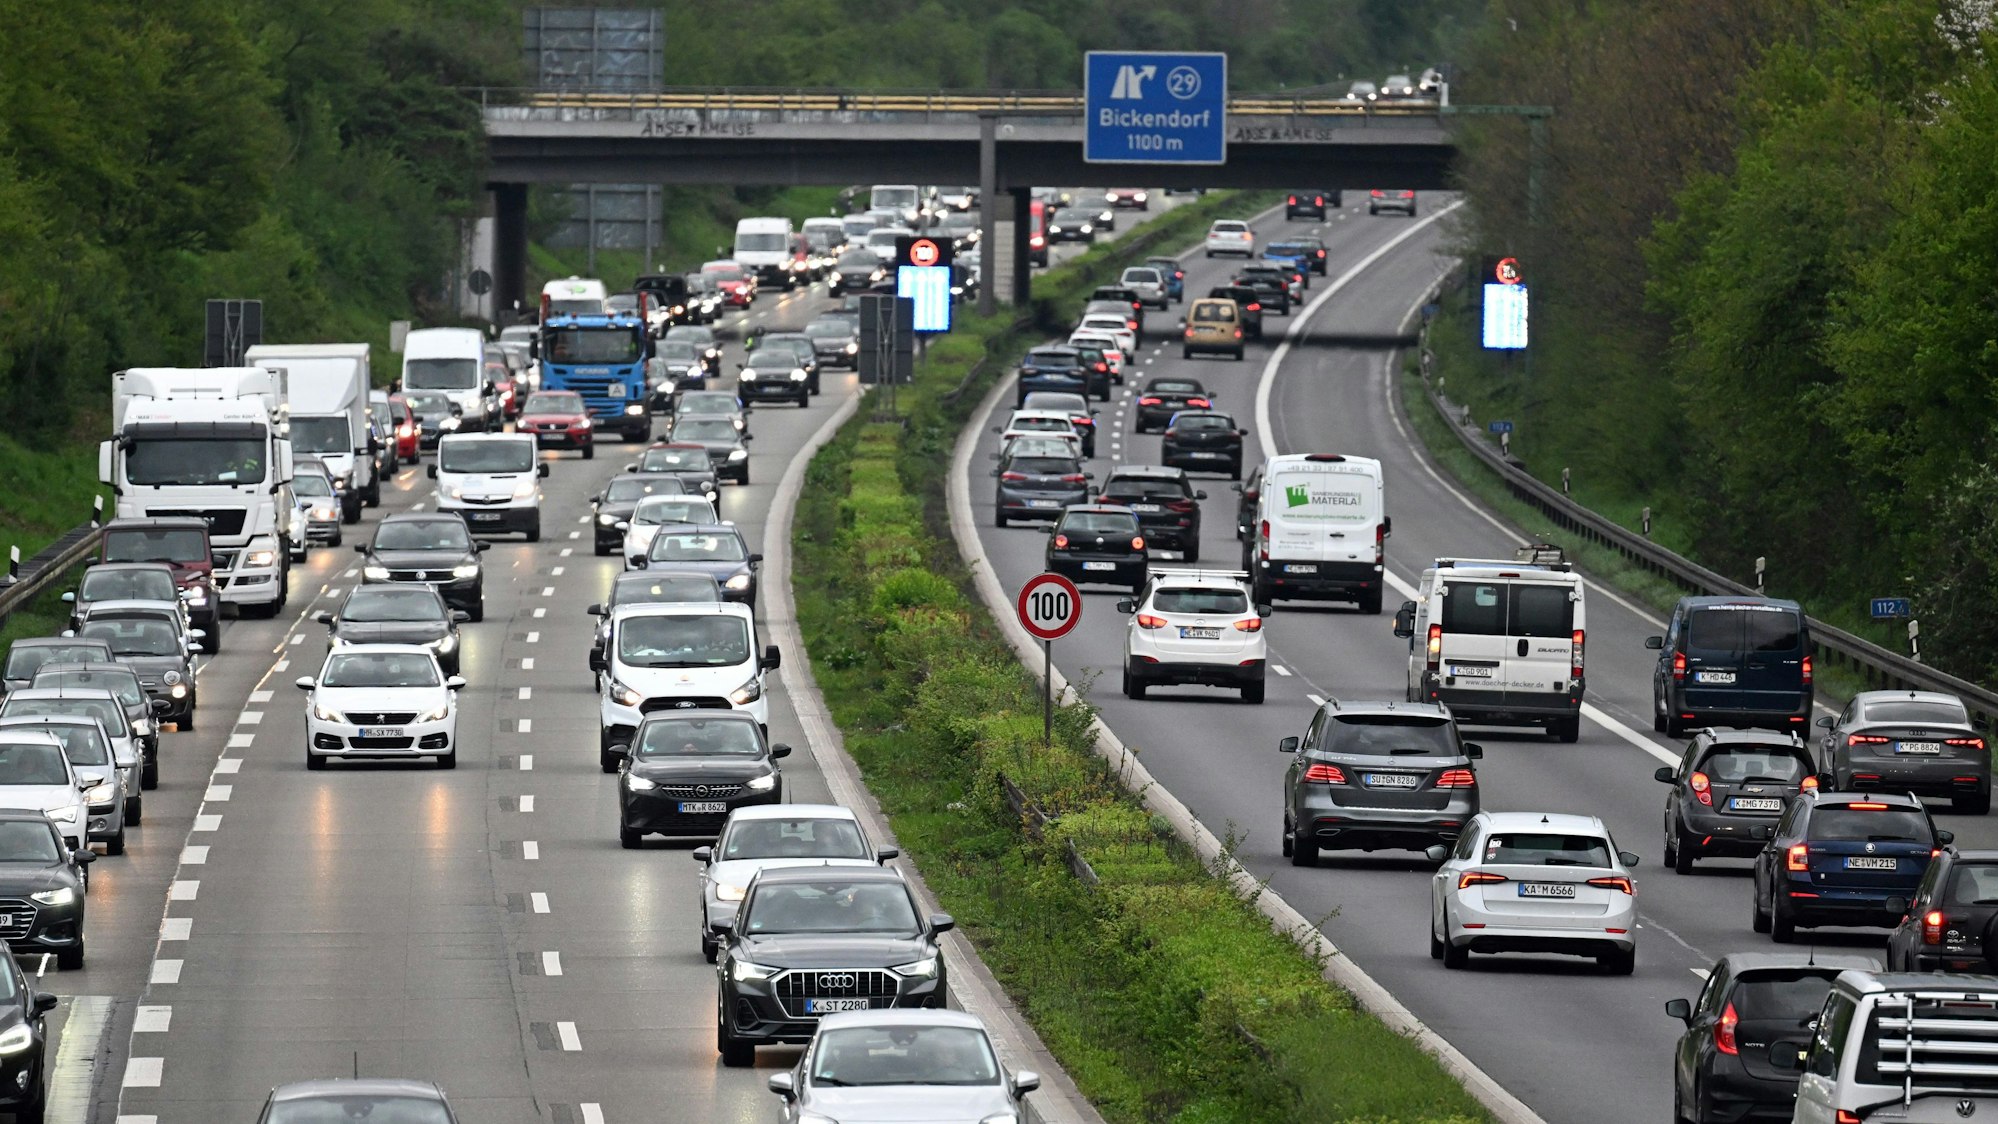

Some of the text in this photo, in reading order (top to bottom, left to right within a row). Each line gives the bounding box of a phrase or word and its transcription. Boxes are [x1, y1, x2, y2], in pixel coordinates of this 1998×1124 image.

[1171, 73, 1195, 92] 29
[1100, 108, 1210, 128] Bickendorf
[1127, 134, 1184, 150] 1100 m
[1312, 496, 1358, 506] MATERLA
[1031, 592, 1068, 620] 100
[1878, 602, 1895, 614] 112
[1372, 775, 1414, 784] SU GN 8286
[683, 803, 726, 811] MTK R 8622
[1758, 800, 1779, 808] 7378
[1849, 858, 1896, 868] NE VM 215
[1524, 885, 1574, 896] KA M 6566
[812, 1001, 868, 1011] K ST 2280
